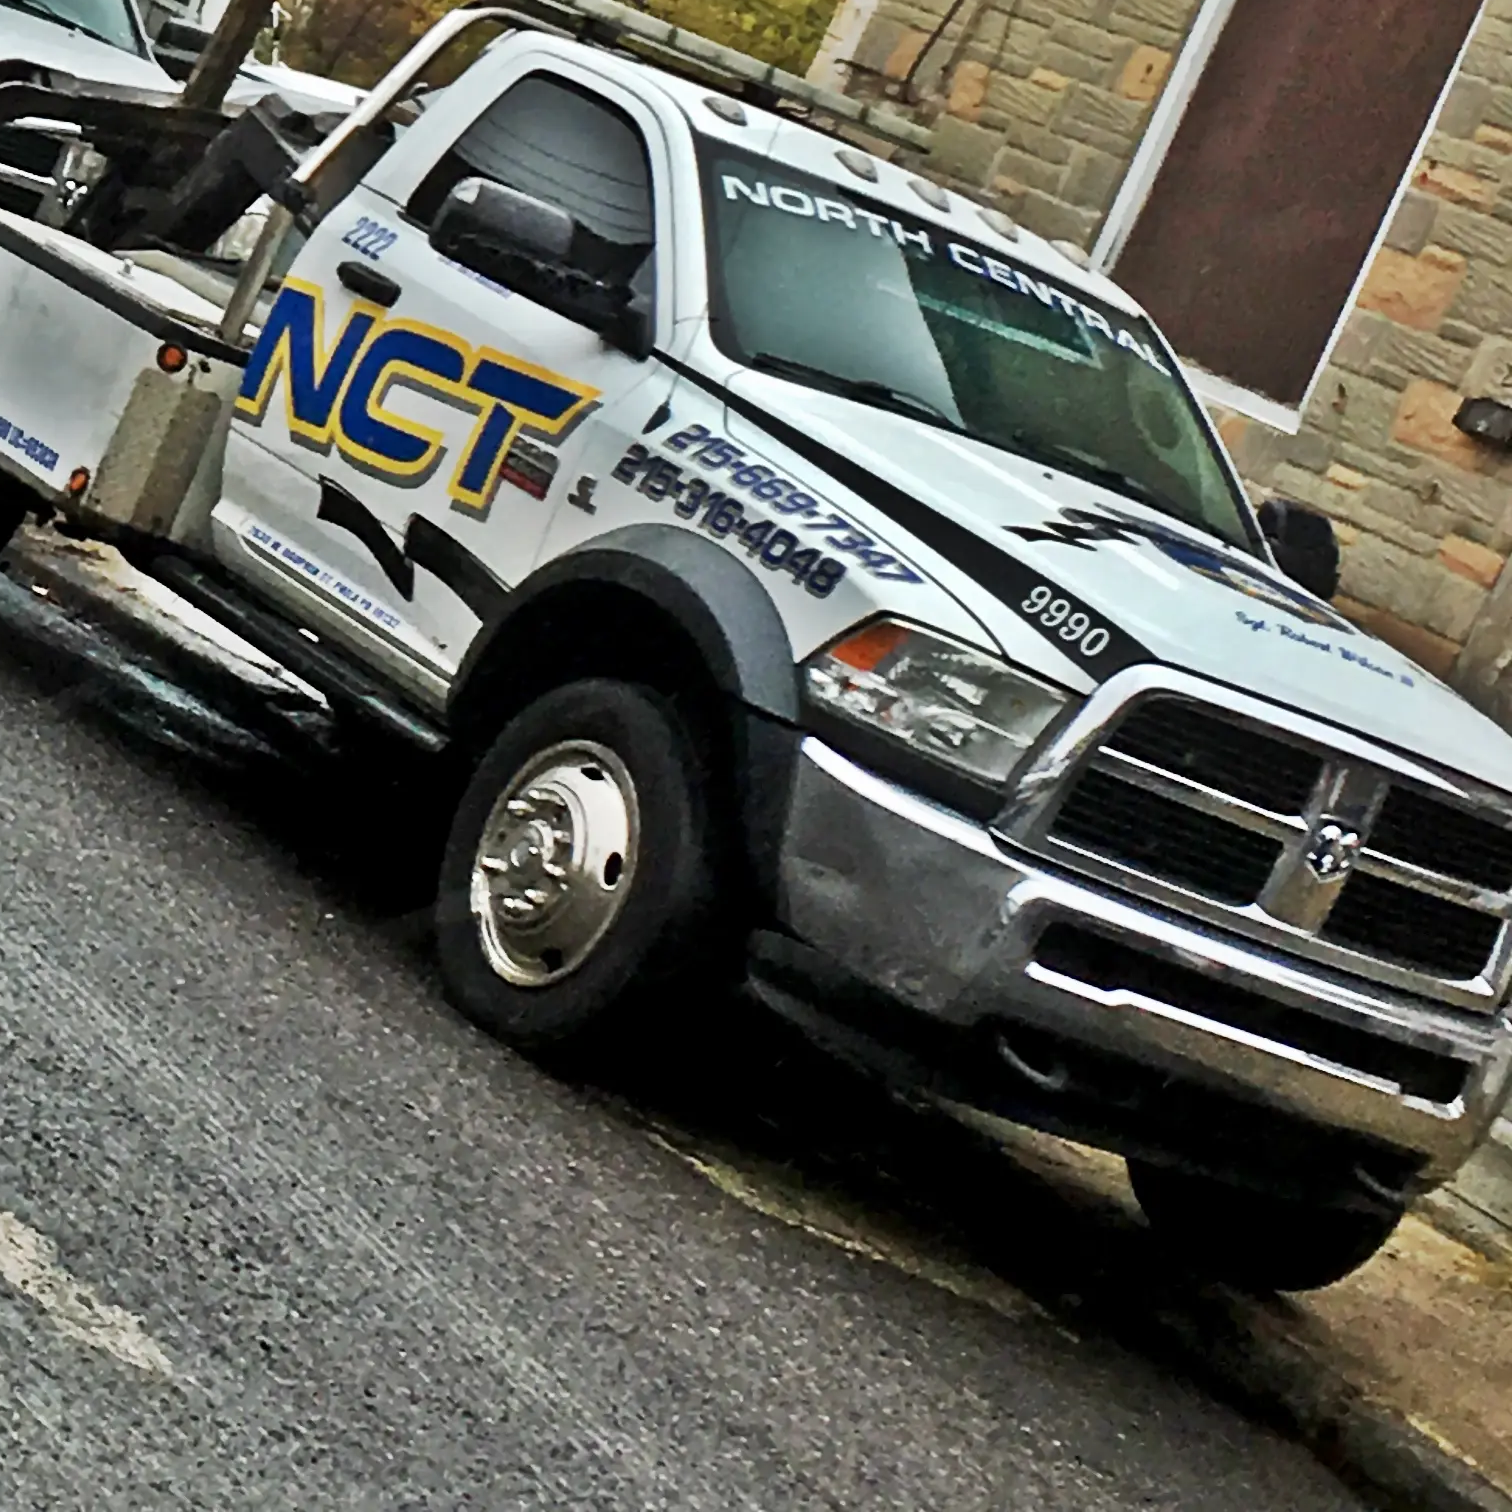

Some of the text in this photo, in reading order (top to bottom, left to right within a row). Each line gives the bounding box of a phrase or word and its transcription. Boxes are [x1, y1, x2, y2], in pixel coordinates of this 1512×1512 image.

[341, 215, 399, 262] 2222
[721, 174, 1174, 378] NORTH CENTRAL
[232, 274, 604, 523] NCT
[1021, 585, 1110, 657] 9990
